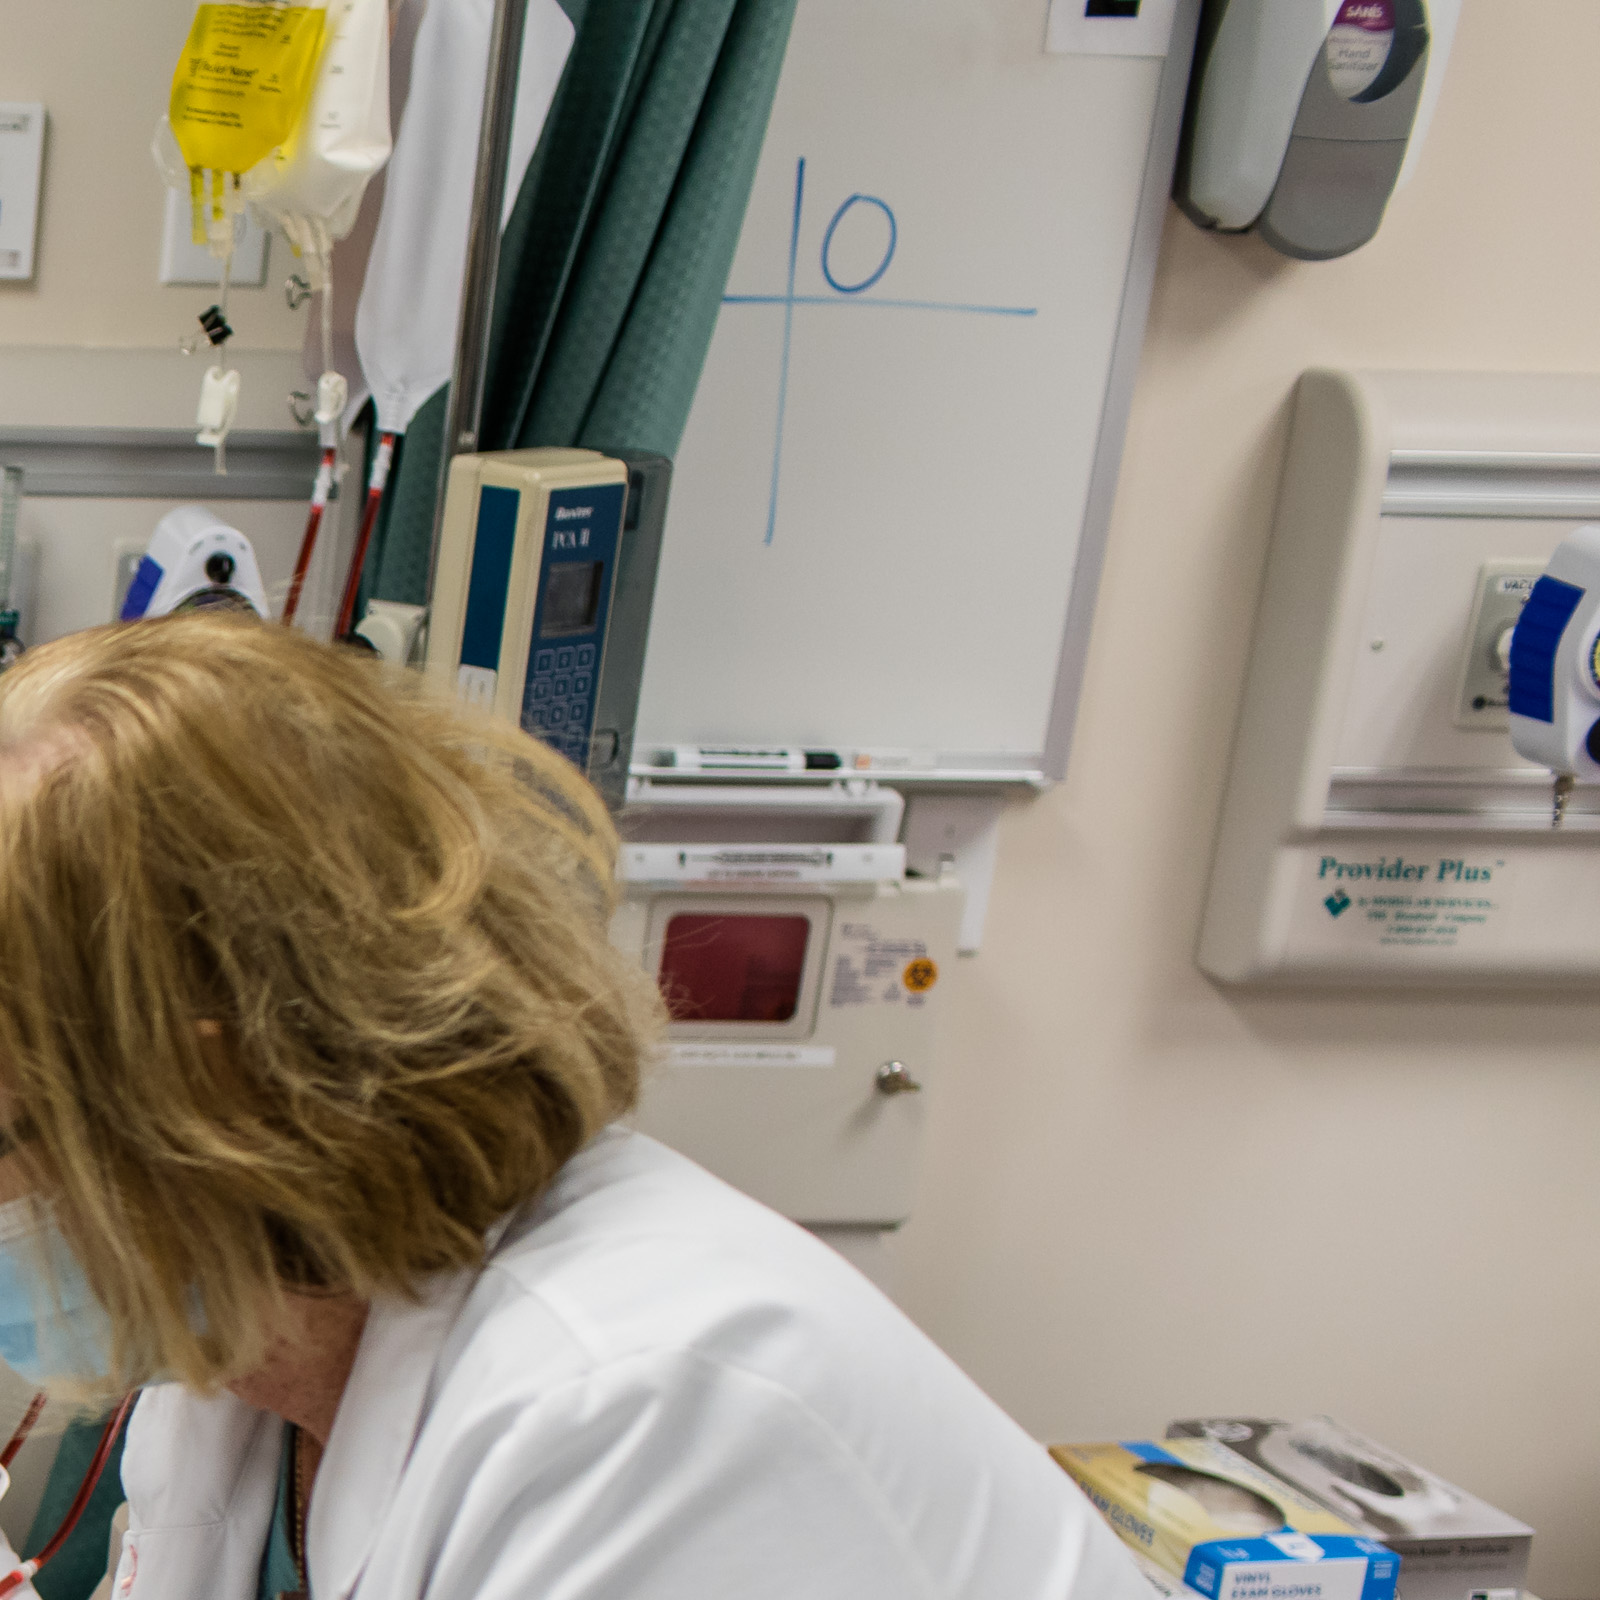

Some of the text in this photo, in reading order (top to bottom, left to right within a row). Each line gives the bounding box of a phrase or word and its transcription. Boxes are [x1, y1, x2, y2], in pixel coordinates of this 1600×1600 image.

[1318, 856, 1491, 882] Provider Plus
[1234, 1573, 1270, 1584] VINYL
[1231, 1584, 1322, 1599] EXAM GLOVES
